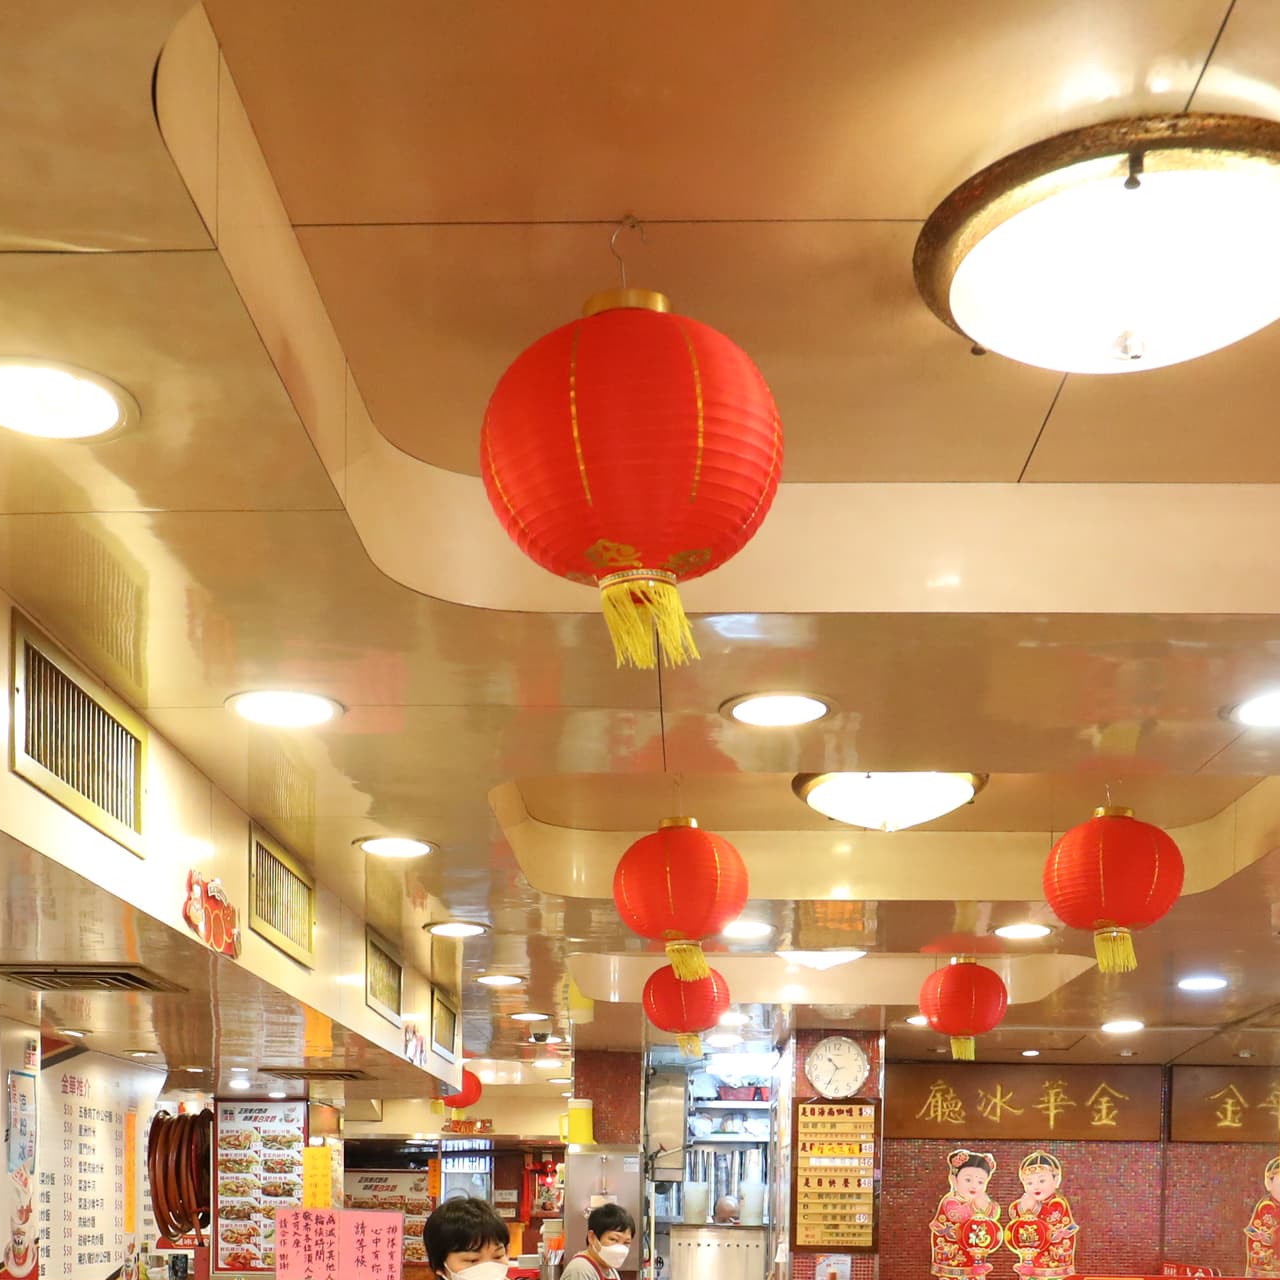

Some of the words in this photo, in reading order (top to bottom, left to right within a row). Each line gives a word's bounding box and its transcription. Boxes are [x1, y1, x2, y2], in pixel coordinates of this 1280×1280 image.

[833, 1043, 842, 1051] 12
[61, 1072, 91, 1099] 金華推介
[916, 1079, 1130, 1130] 金華冰廳
[804, 1177, 850, 1188] 是日快餐
[325, 1213, 336, 1280] 為減少其他人
[354, 1220, 367, 1268] 請等候
